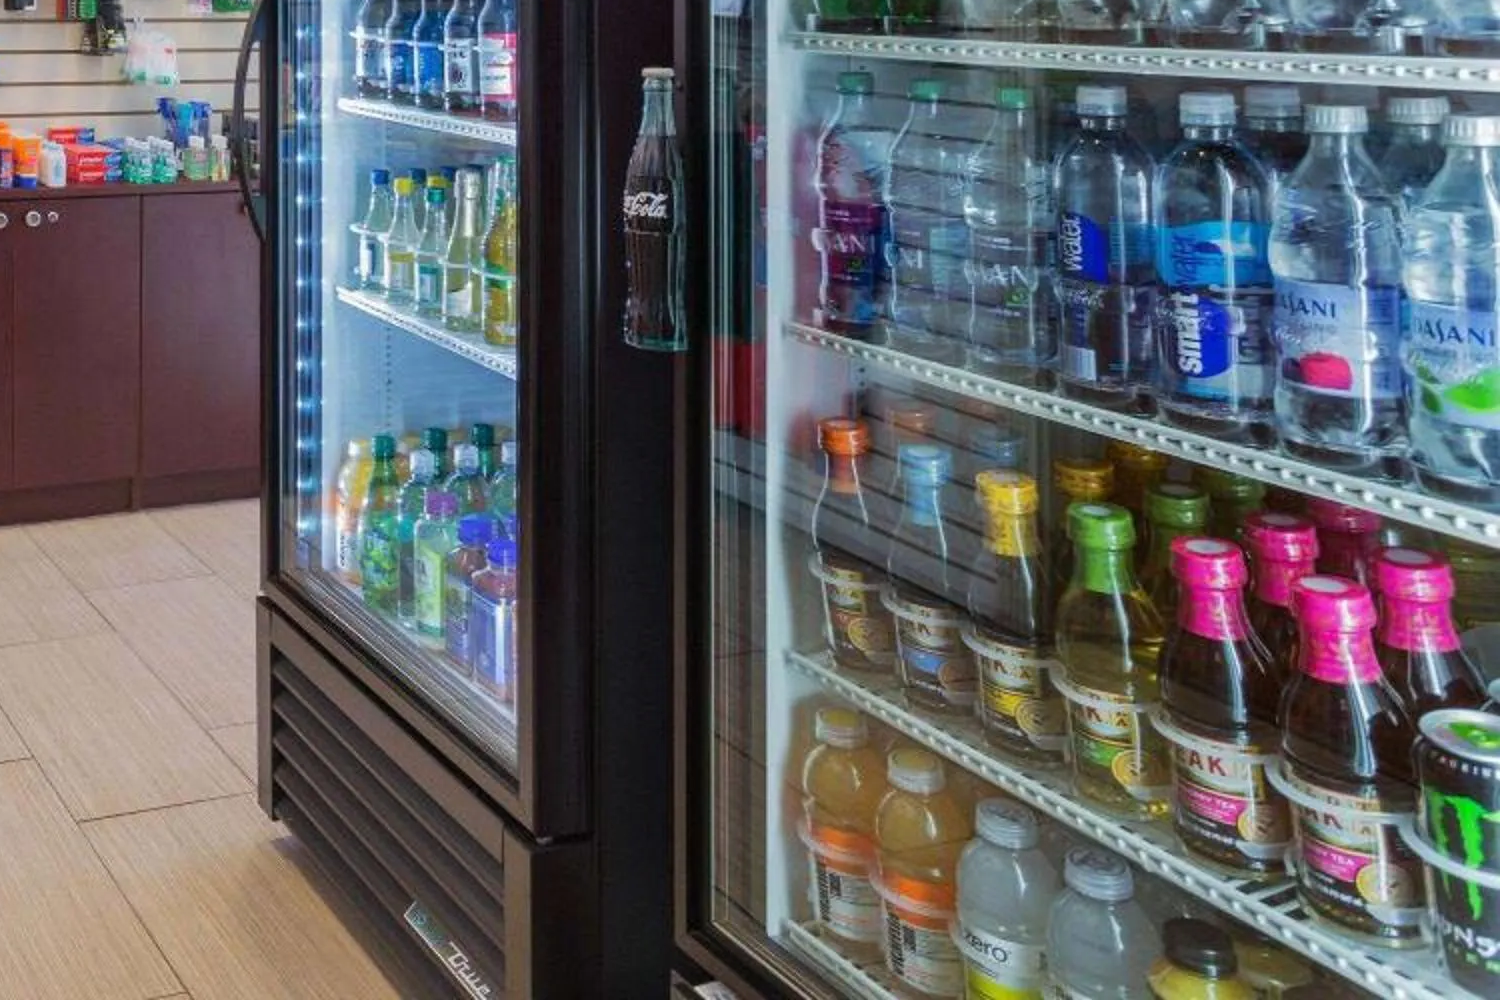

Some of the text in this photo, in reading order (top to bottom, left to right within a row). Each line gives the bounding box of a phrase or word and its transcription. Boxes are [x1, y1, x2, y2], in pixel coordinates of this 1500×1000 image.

[1061, 213, 1084, 273] water
[1280, 293, 1337, 319] ASANI
[963, 928, 1008, 963] zero
